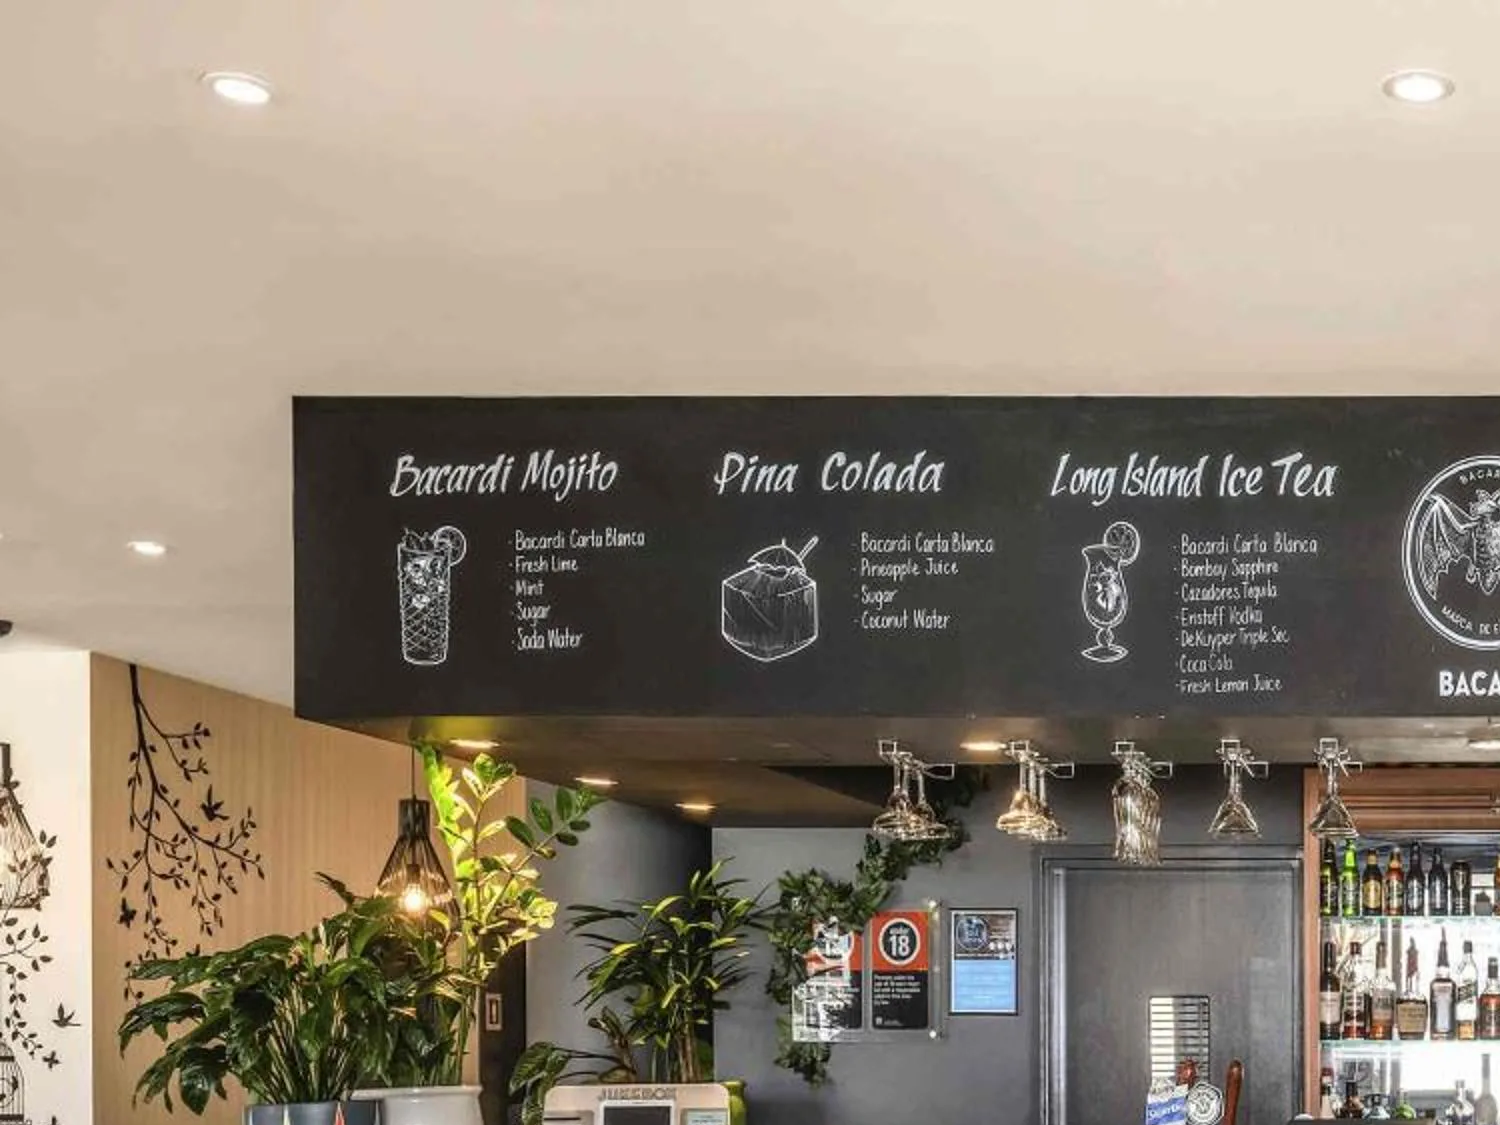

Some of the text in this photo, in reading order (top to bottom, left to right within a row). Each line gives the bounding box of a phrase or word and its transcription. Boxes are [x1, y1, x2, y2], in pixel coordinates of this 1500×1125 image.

[389, 449, 619, 502] Bacardi Mojito
[713, 450, 945, 495] Pina Colada
[1051, 451, 1338, 506] Long Island Ice Tea
[515, 530, 566, 551] Bacardi
[605, 528, 645, 548] Blanca
[861, 531, 994, 553] Bacardi Carta Blanca
[1181, 531, 1318, 555] Bacardi Carta Blanca
[515, 555, 579, 574] Fresh Lime
[861, 557, 959, 582] Pineapple Juice
[515, 579, 545, 597] Mint
[861, 584, 898, 610] Sugar
[517, 600, 551, 627] Sugar
[861, 609, 952, 630] Coconut Water
[517, 626, 583, 651] Soda Water
[1271, 625, 1290, 643] Sec
[1215, 676, 1249, 693] Lemon
[1253, 673, 1283, 692] Juice
[889, 935, 911, 957] 18
